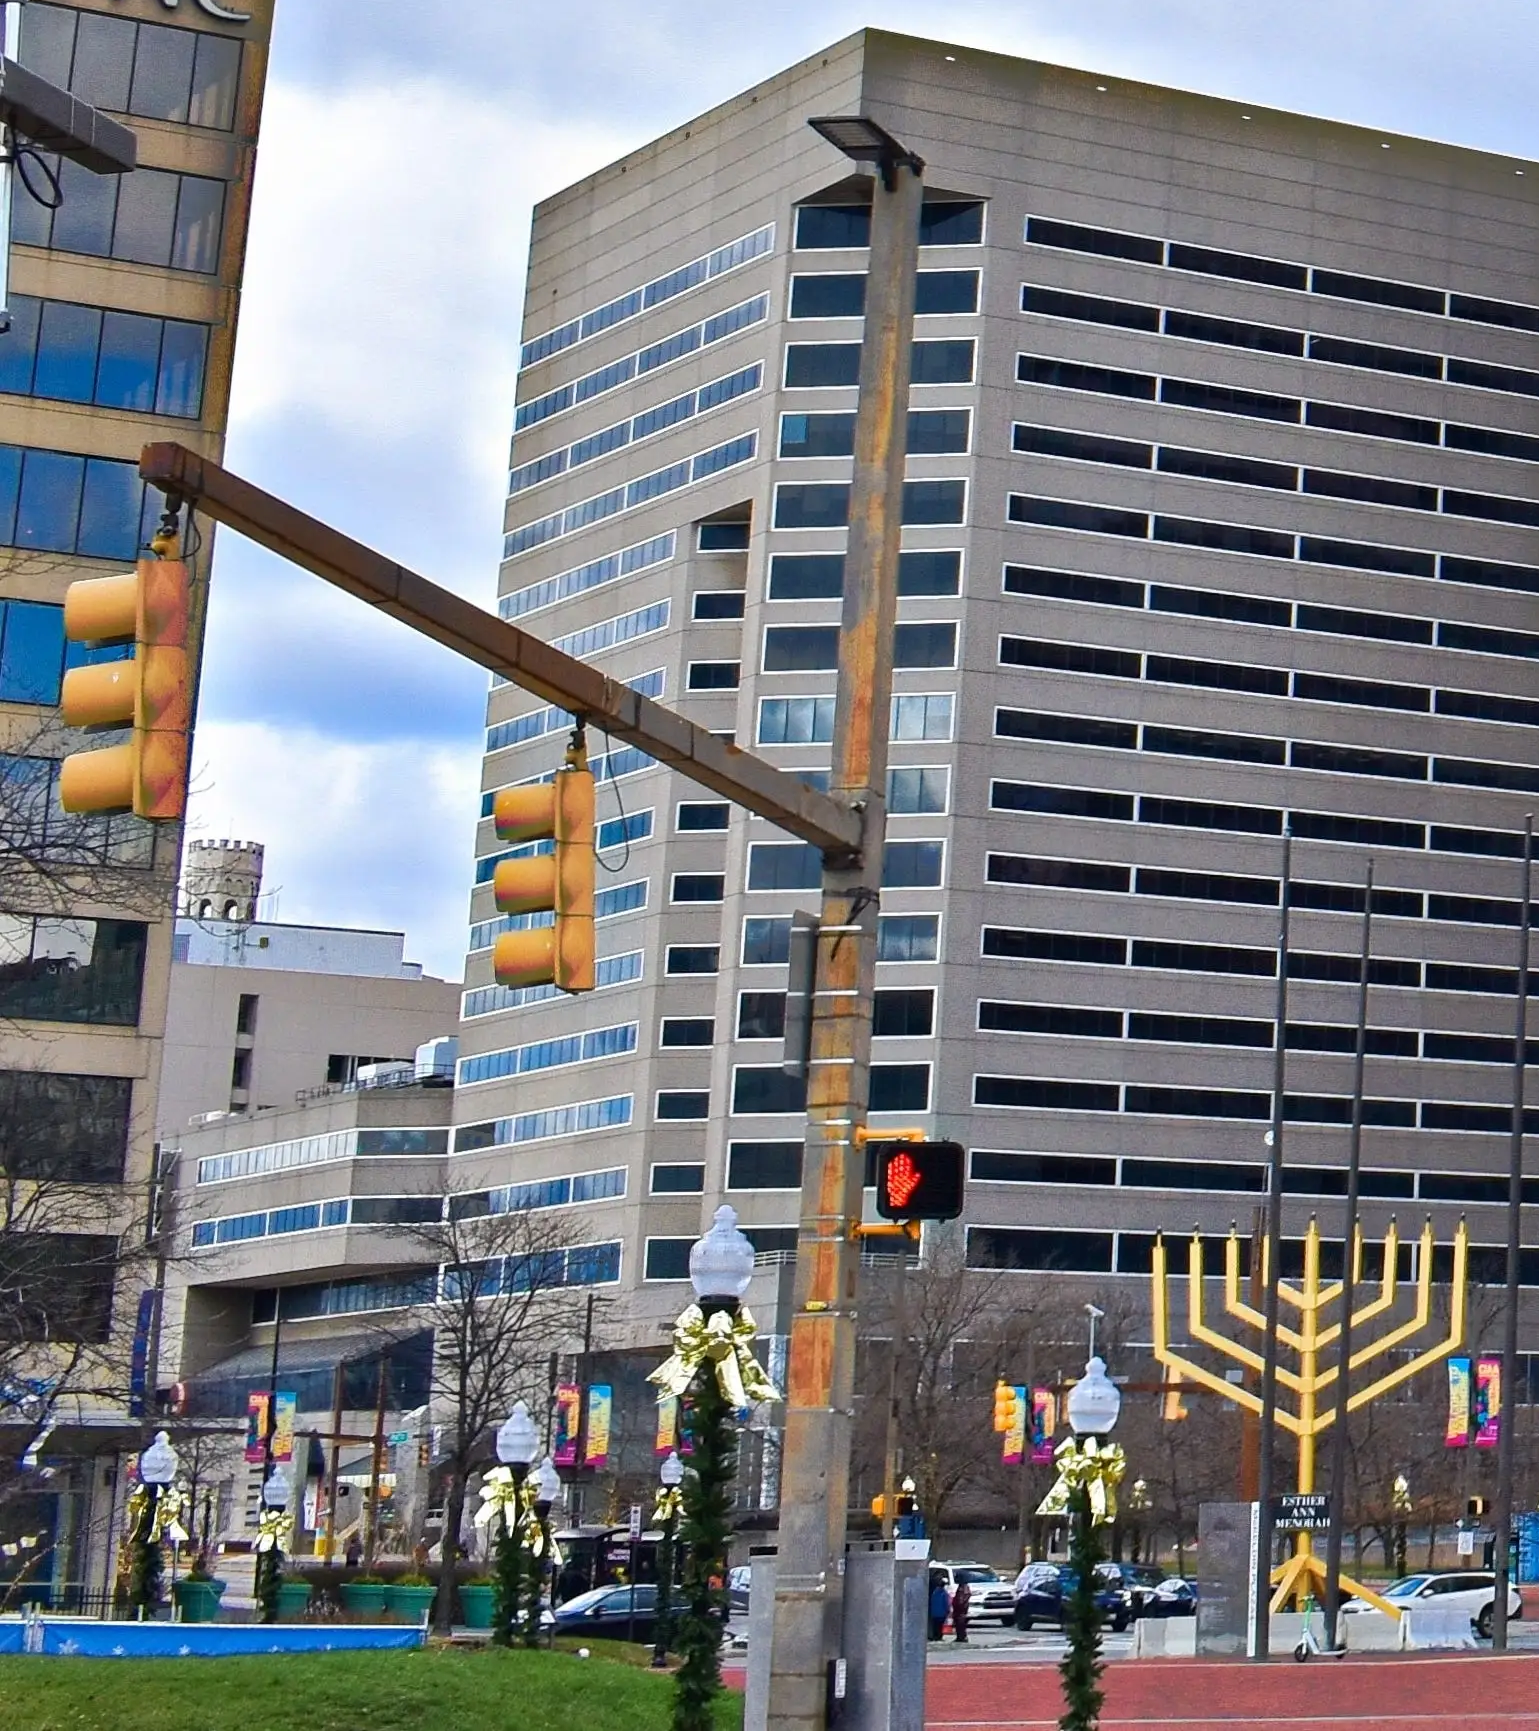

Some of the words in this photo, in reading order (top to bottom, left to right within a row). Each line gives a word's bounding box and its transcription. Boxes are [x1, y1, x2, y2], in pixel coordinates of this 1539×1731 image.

[1281, 1495, 1326, 1507] ESTHER
[1291, 1507, 1316, 1517] ANN
[1274, 1517, 1331, 1529] MENORAH
